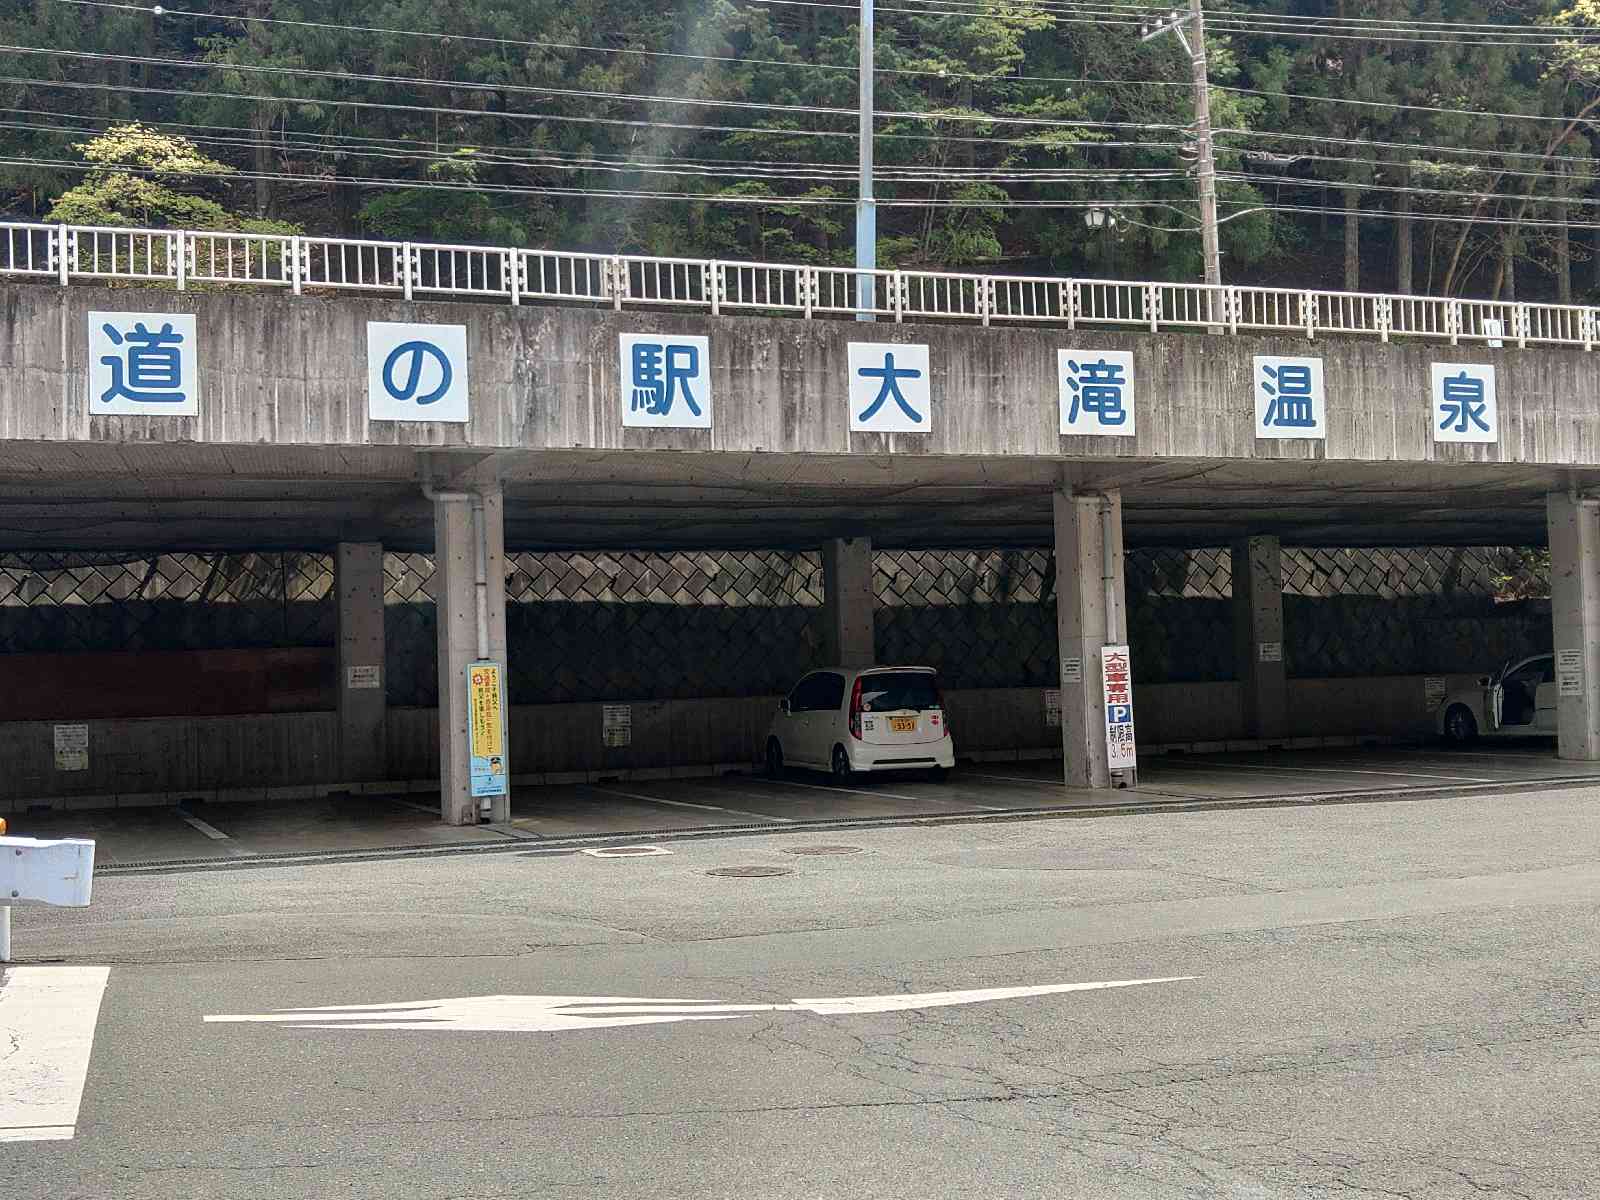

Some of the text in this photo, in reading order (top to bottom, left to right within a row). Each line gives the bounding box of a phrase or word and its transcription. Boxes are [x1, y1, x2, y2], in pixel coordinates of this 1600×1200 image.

[1104, 652, 1129, 704] 大型車専用
[1113, 706, 1127, 721] P
